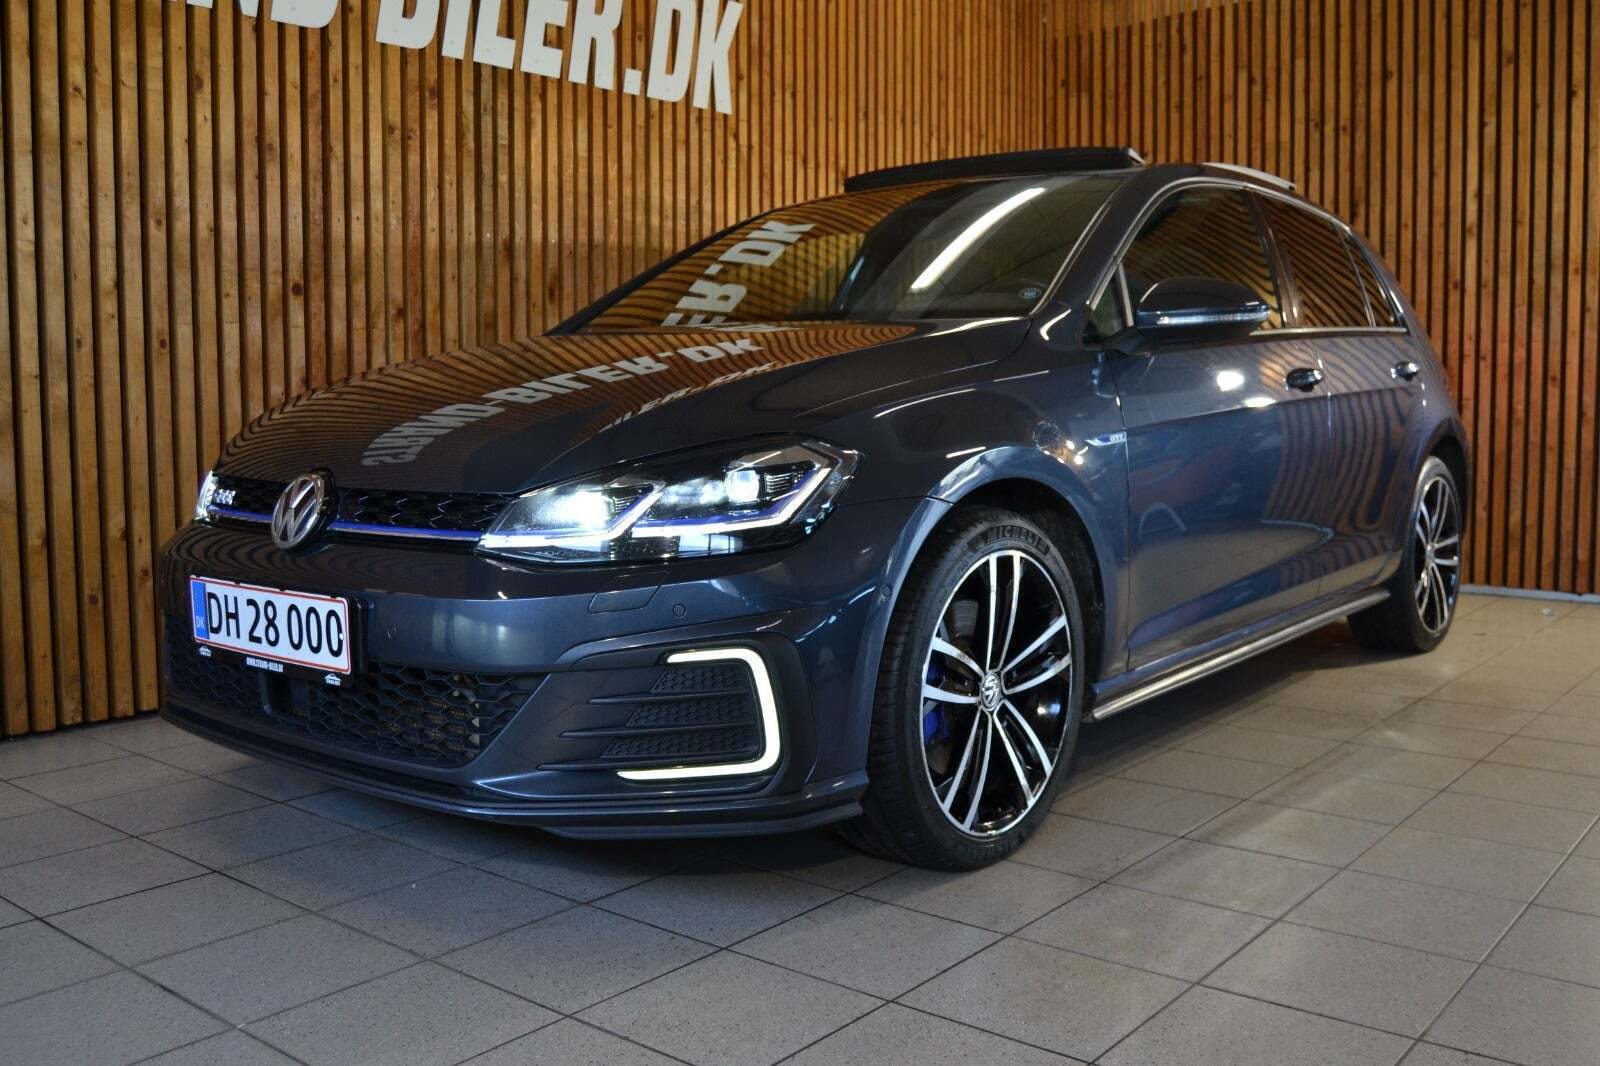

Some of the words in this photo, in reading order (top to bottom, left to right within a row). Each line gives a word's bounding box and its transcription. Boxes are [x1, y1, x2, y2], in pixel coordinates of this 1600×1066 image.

[207, 591, 241, 640] DH
[246, 598, 280, 648] 28
[287, 603, 344, 658] 000
